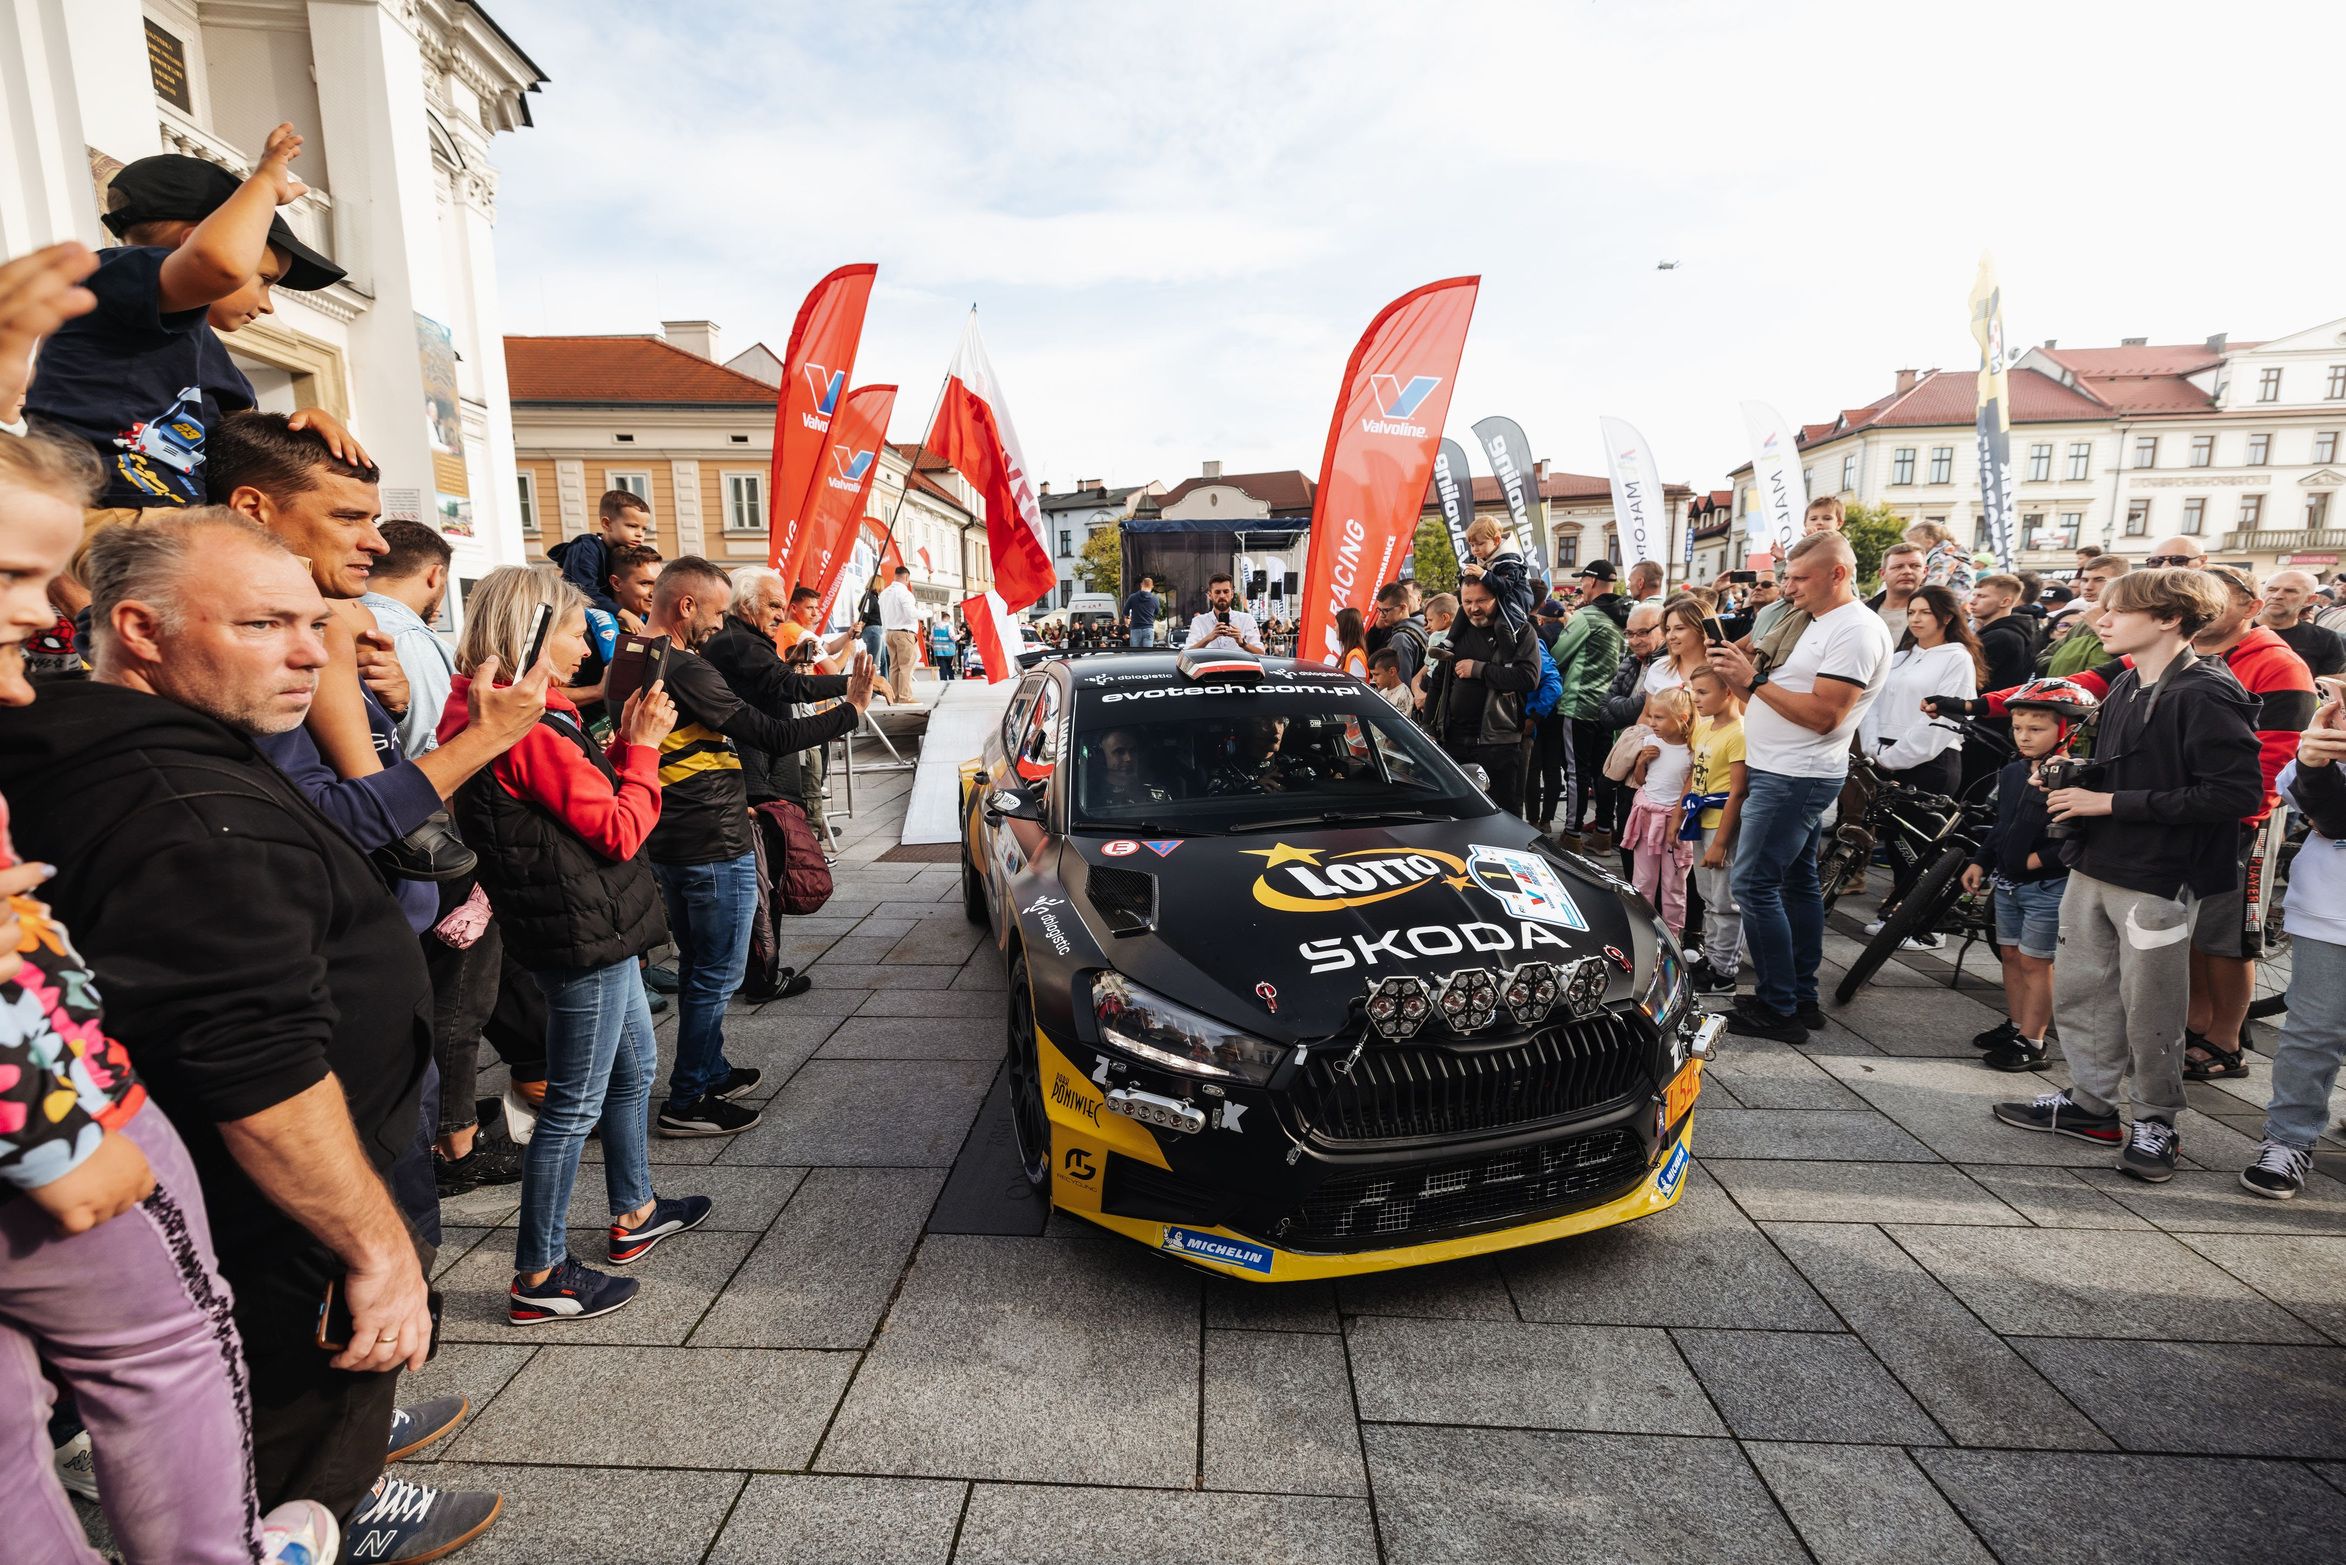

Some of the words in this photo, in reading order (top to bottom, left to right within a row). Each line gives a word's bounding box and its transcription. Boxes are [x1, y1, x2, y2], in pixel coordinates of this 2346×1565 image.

[171, 423, 202, 440] 23
[802, 411, 831, 433] Valvo
[1361, 418, 1424, 438] Valvoline
[828, 476, 861, 492] Valvolin
[1329, 518, 1365, 610] RACING
[1117, 672, 1173, 682] dblogistic
[1298, 671, 1345, 679] dblogistic
[1102, 683, 1361, 703] evotech.com.pl
[1112, 841, 1129, 853] E
[1284, 855, 1441, 897] LOTTO
[1479, 870, 1512, 880] 1
[1041, 913, 1070, 956] dblogistic
[1051, 1081, 1103, 1128] PONIWIEC
[1666, 1147, 1684, 1183] MICHELIN
[1057, 1172, 1097, 1193] RECYCLING
[1186, 1237, 1263, 1264] MICHELIN
[353, 1529, 398, 1558] N
